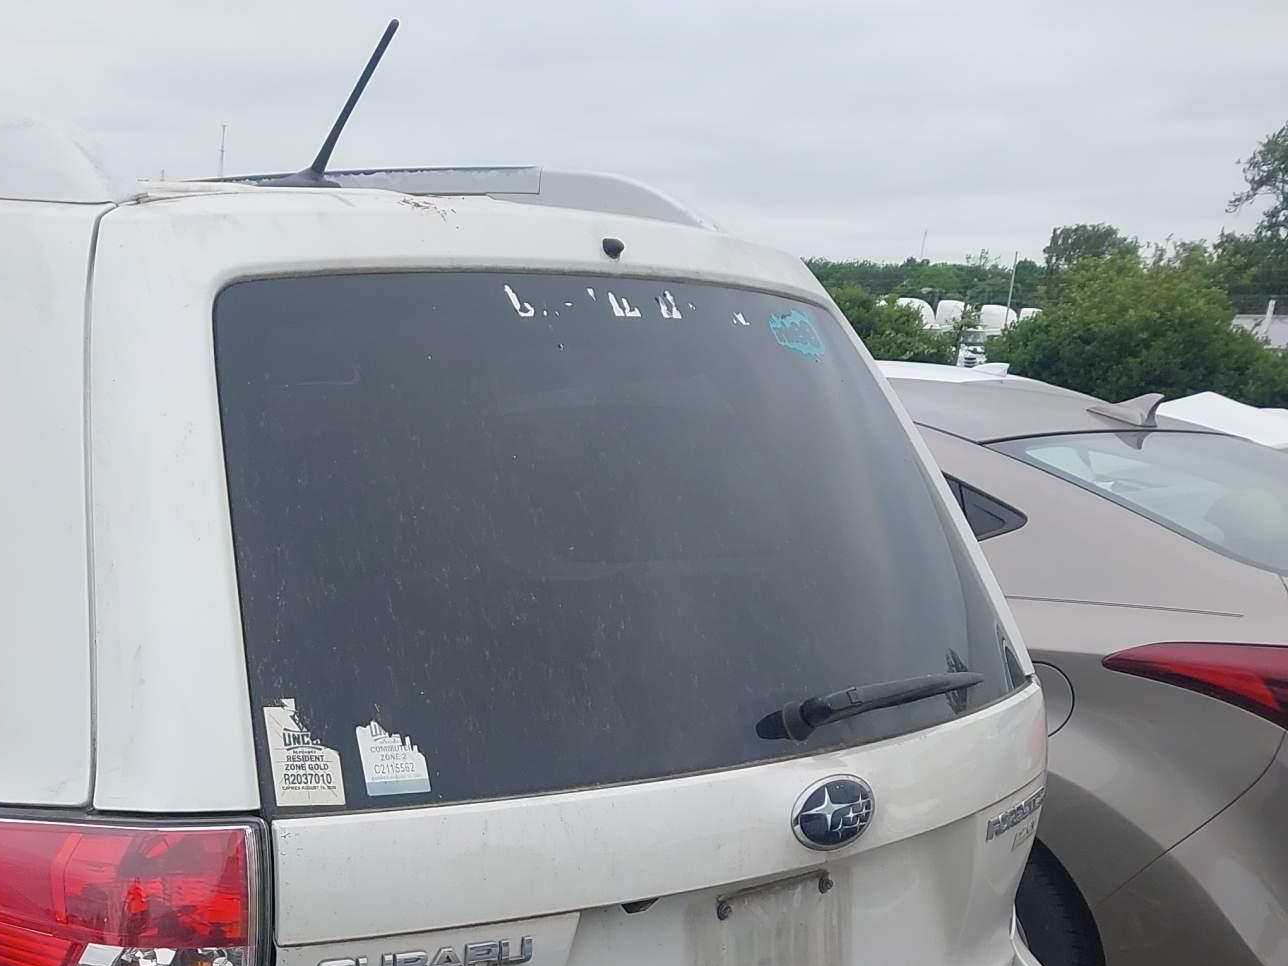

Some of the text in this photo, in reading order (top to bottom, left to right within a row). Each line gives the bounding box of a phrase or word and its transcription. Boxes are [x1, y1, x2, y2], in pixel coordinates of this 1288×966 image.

[286, 754, 325, 763] RESIDENT
[284, 763, 329, 771] ZONE GOLD
[283, 773, 332, 785] R2037010
